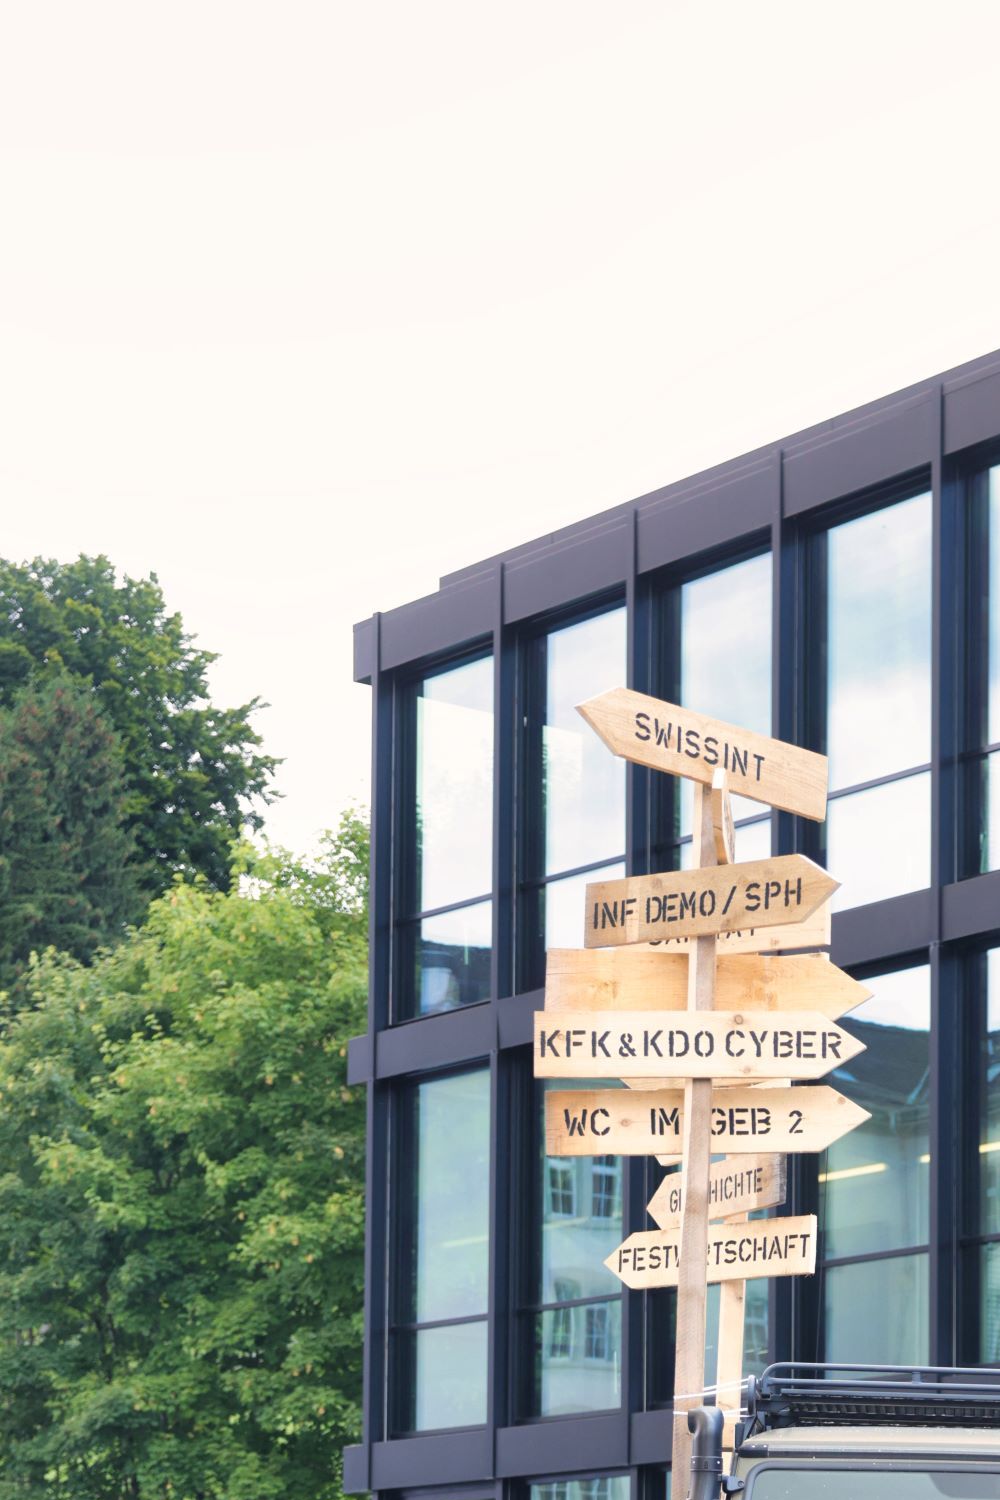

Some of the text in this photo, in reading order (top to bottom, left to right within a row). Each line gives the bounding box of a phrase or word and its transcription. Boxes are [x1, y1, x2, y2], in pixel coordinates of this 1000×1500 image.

[634, 711, 765, 782] SWISSINT
[592, 898, 637, 930] INF
[725, 1029, 842, 1059] CYBER
[563, 1107, 803, 1137] WC IM GEB 2
